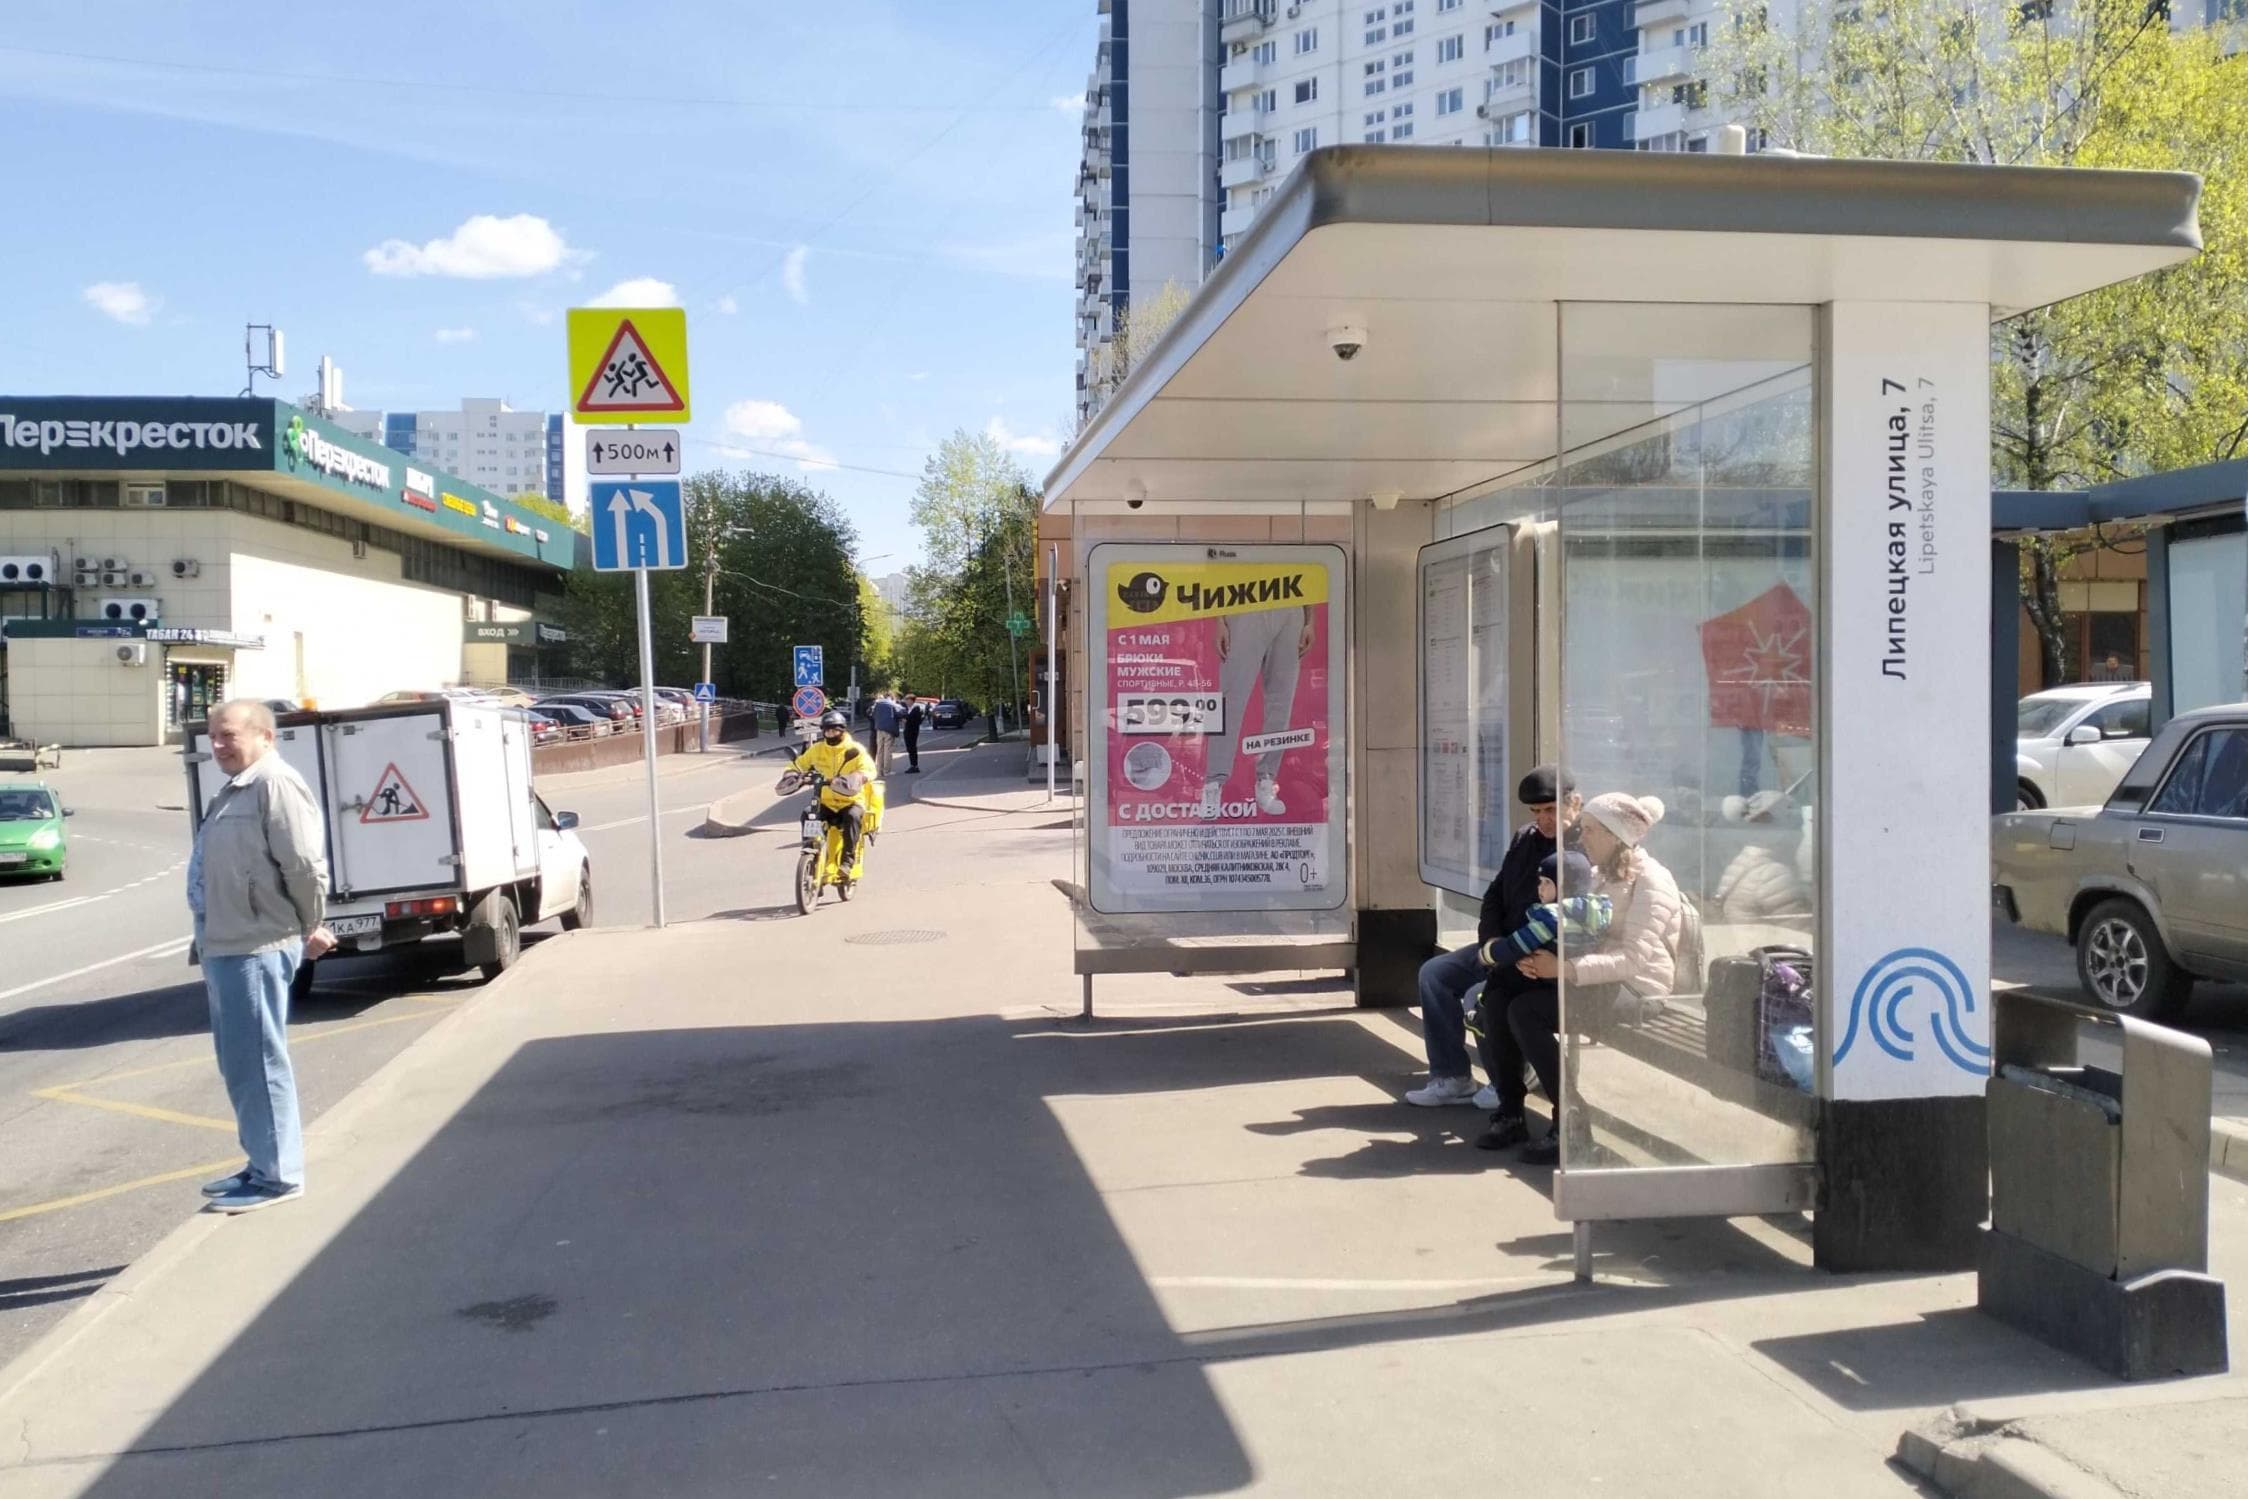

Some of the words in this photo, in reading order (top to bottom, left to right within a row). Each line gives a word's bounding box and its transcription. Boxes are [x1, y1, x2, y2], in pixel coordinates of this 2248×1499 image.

[1882, 377, 1907, 396] 7
[1918, 377, 1935, 389] 7
[0, 414, 262, 456] Перекресток
[1917, 397, 1938, 460] Ulitsa,
[607, 443, 660, 460] 500м
[1888, 406, 1912, 511] улица,
[1917, 466, 1938, 575] Lipetskaya
[1176, 574, 1304, 611] ЧИЖИК
[1882, 521, 1909, 681] Липецкая
[477, 627, 505, 638] ВХОД
[1118, 634, 1127, 645] С
[1129, 635, 1136, 645] 1
[1139, 635, 1170, 645] МАЯ
[1117, 652, 1164, 663] БРЮКИ
[1117, 666, 1181, 677] МУЖСКИЕ
[1126, 698, 1190, 725] 599
[1246, 740, 1261, 750] НА
[1264, 734, 1310, 747] РЕЗИНКЕ
[1119, 803, 1131, 819] С
[1135, 797, 1257, 821] ДОСТАВКОЙ
[1300, 862, 1318, 884] 0+
[323, 921, 354, 934] 1КА
